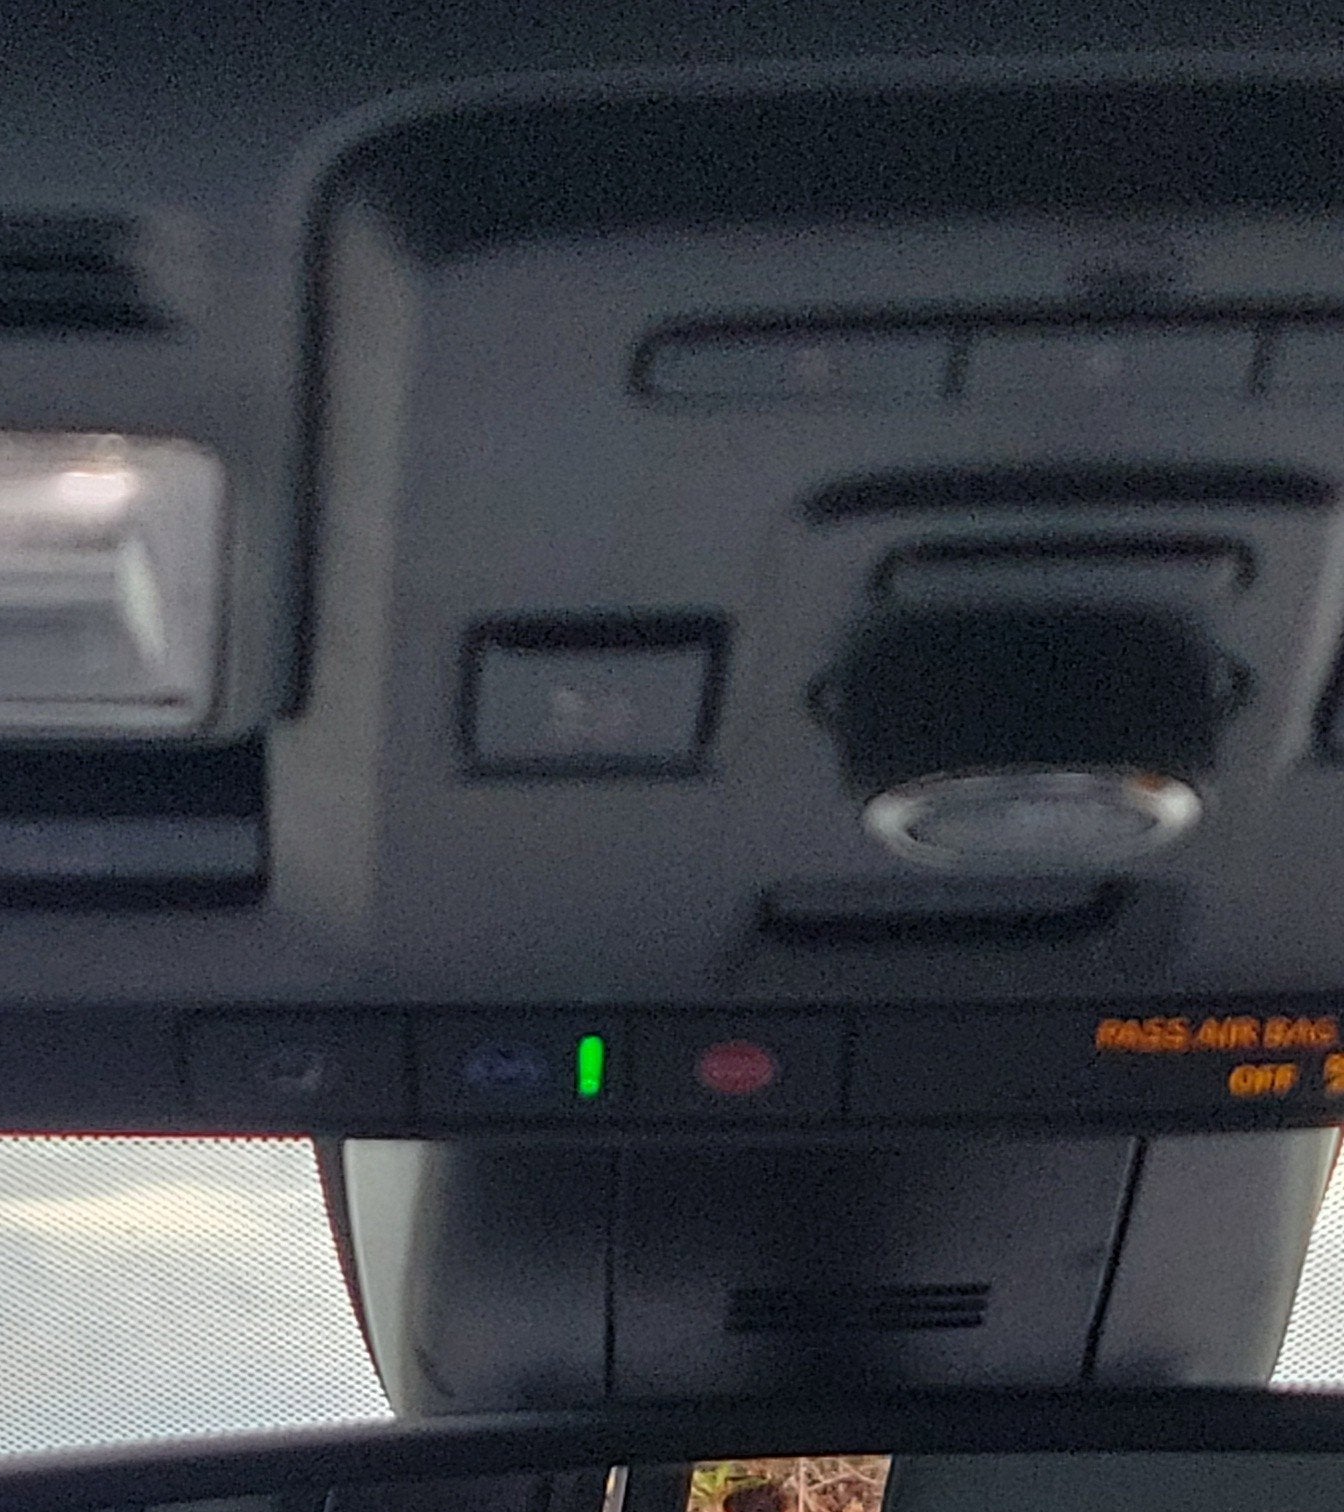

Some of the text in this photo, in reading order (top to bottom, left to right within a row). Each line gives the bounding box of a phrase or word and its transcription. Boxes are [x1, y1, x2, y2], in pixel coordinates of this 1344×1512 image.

[1096, 1015, 1339, 1052] PASS AIR BAG
[1228, 1063, 1298, 1096] OFF
